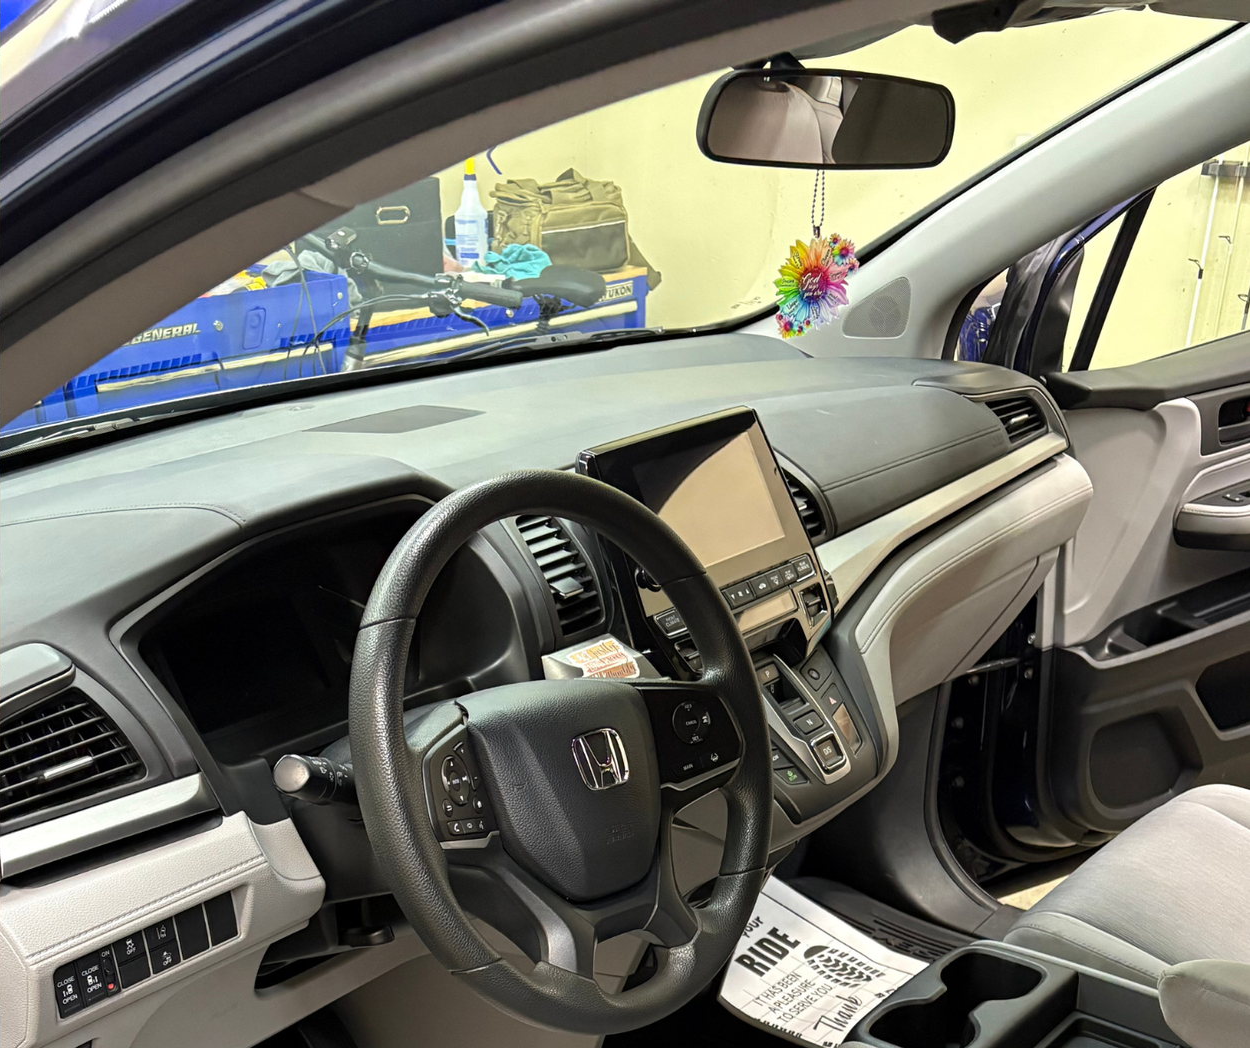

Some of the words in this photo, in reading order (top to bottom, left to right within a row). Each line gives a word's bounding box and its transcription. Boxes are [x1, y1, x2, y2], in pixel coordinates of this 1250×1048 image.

[802, 272, 822, 290] God
[130, 322, 201, 345] GENERAL
[743, 916, 763, 938] your
[101, 949, 110, 957] ON
[126, 946, 136, 955] OFF
[735, 927, 801, 977] RIDE
[81, 964, 99, 977] CLOSE
[57, 975, 75, 988] CLOSE
[87, 982, 102, 993] OPEN
[752, 997, 767, 1006] IT
[761, 985, 783, 1000] HAS
[777, 971, 802, 989] BEEN
[62, 994, 78, 1004] OPEN
[773, 979, 816, 1009] PLEASURE
[777, 1012, 794, 1023] TO
[789, 995, 818, 1015] SERVE
[811, 983, 833, 998] YOU
[768, 1006, 780, 1014] A
[813, 995, 863, 1032] Thank
